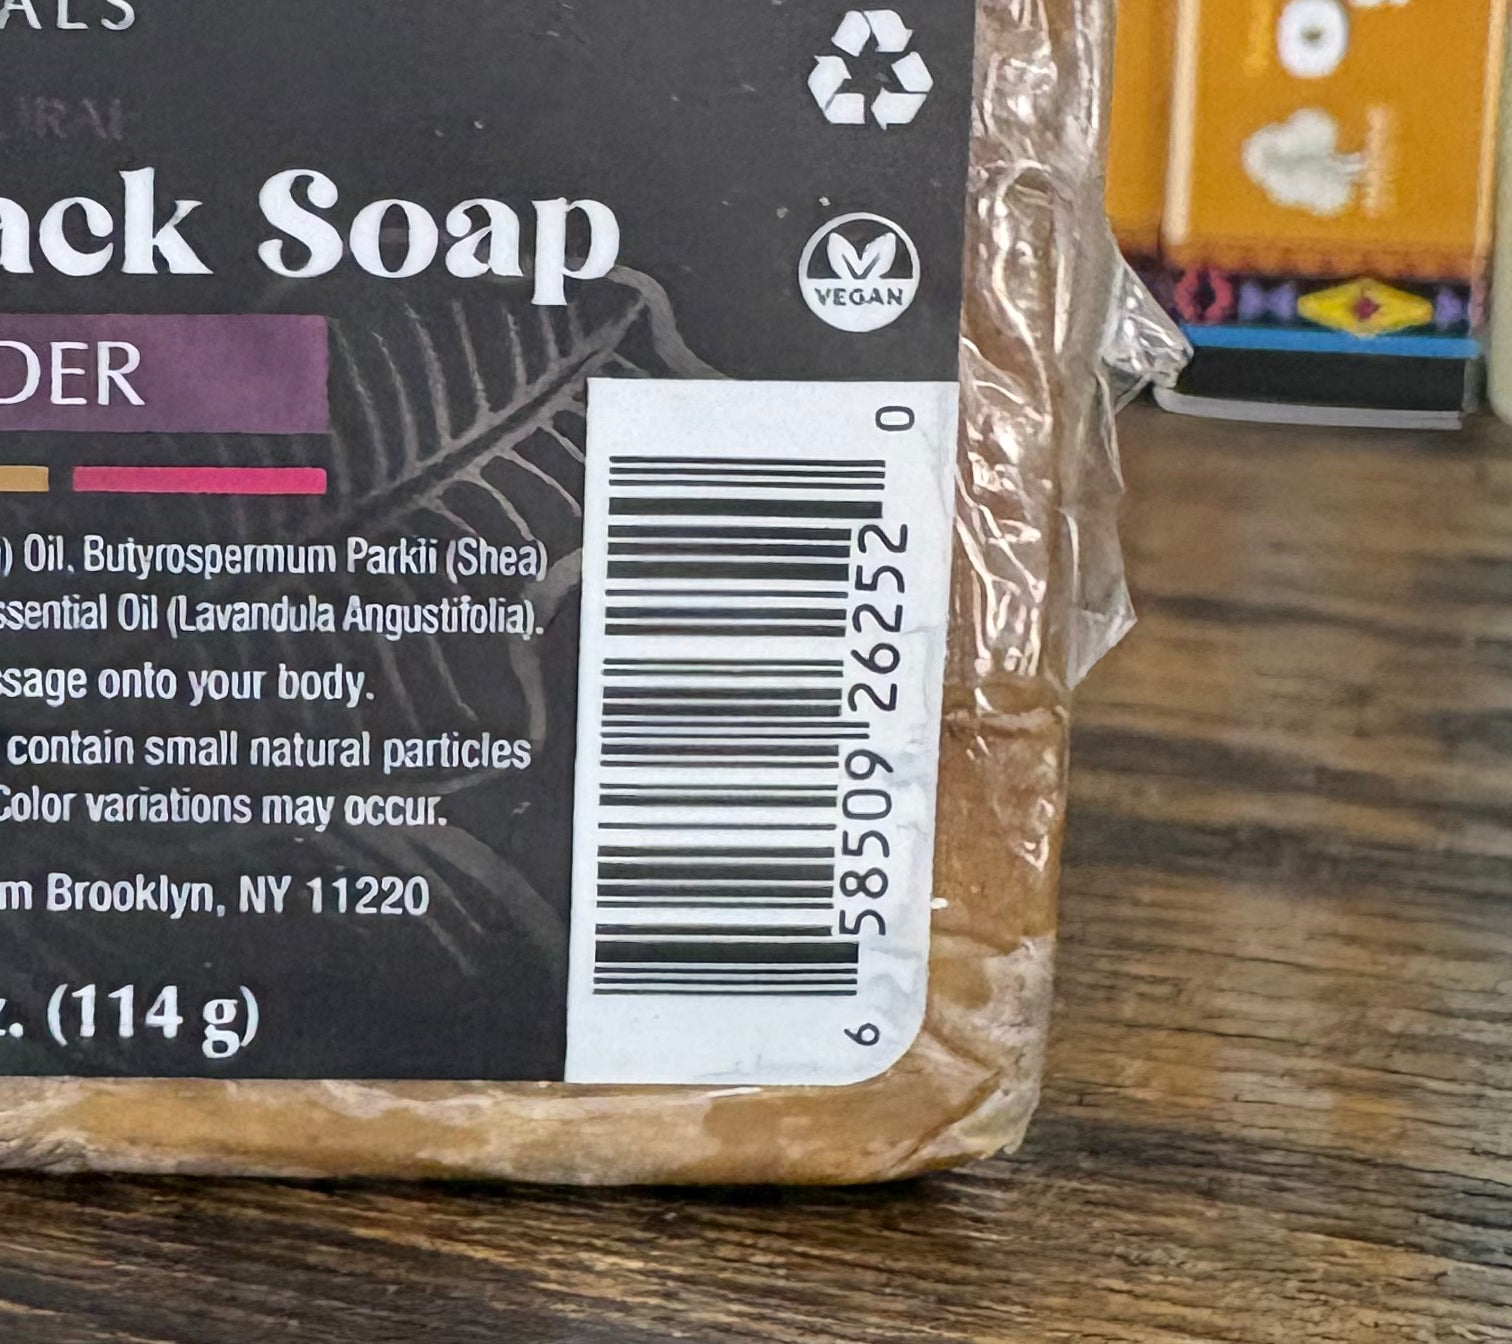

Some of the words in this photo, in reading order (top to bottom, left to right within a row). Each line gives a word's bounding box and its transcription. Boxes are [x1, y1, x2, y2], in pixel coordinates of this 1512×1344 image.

[256, 169, 622, 306] Soap
[813, 287, 904, 307] VEGAN
[874, 405, 915, 431] 0
[83, 534, 336, 581] Butyrospermum
[346, 536, 439, 576] Parkii
[445, 536, 549, 584] (Shea)
[117, 593, 158, 632] Oil
[167, 594, 336, 640] (Lavandula
[846, 522, 909, 713] 26252
[97, 662, 177, 700] onto
[188, 667, 268, 707] your
[278, 663, 375, 708] body.
[6, 729, 135, 767] contain
[143, 730, 238, 767] small
[249, 731, 371, 769] natural
[384, 731, 532, 775] particles
[86, 786, 252, 824] variations
[261, 792, 336, 833] may
[344, 792, 448, 827] occur.
[838, 748, 894, 937] 58509
[45, 872, 226, 918] Brooklyn,
[238, 874, 292, 914] NY
[305, 875, 430, 917] 11220
[46, 984, 184, 1042] (114
[201, 985, 260, 1058] g)
[844, 1022, 880, 1047] 6
